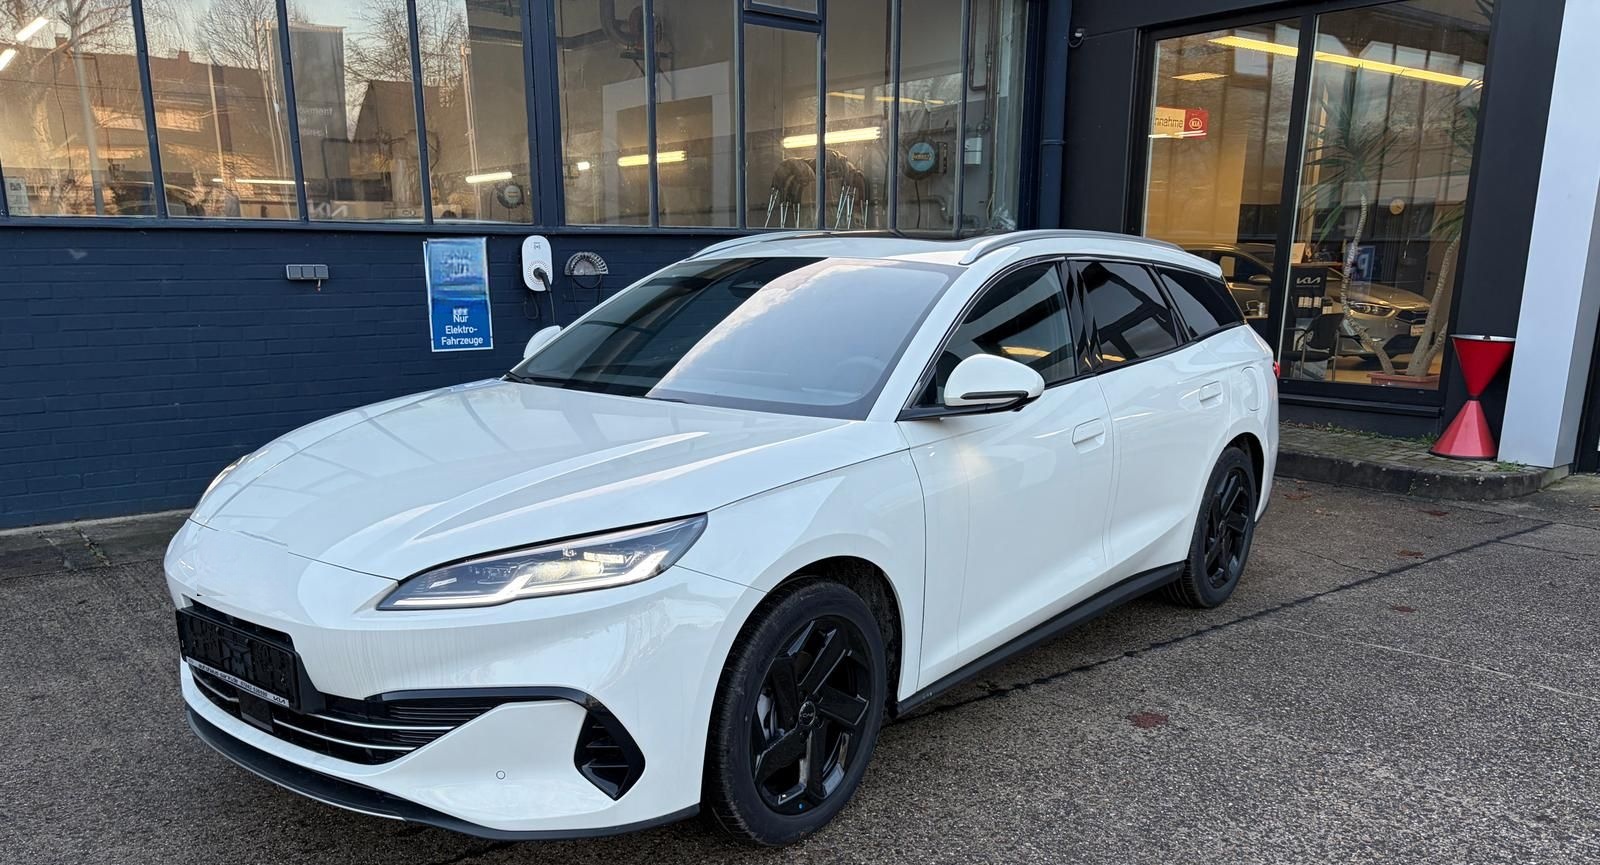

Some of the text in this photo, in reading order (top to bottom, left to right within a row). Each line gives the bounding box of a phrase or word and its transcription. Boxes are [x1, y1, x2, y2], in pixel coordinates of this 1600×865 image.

[1154, 116, 1183, 128] nnahme
[1296, 276, 1321, 284] KIA
[445, 325, 478, 335] Elektro-
[441, 337, 483, 346] Fahrzeuge
